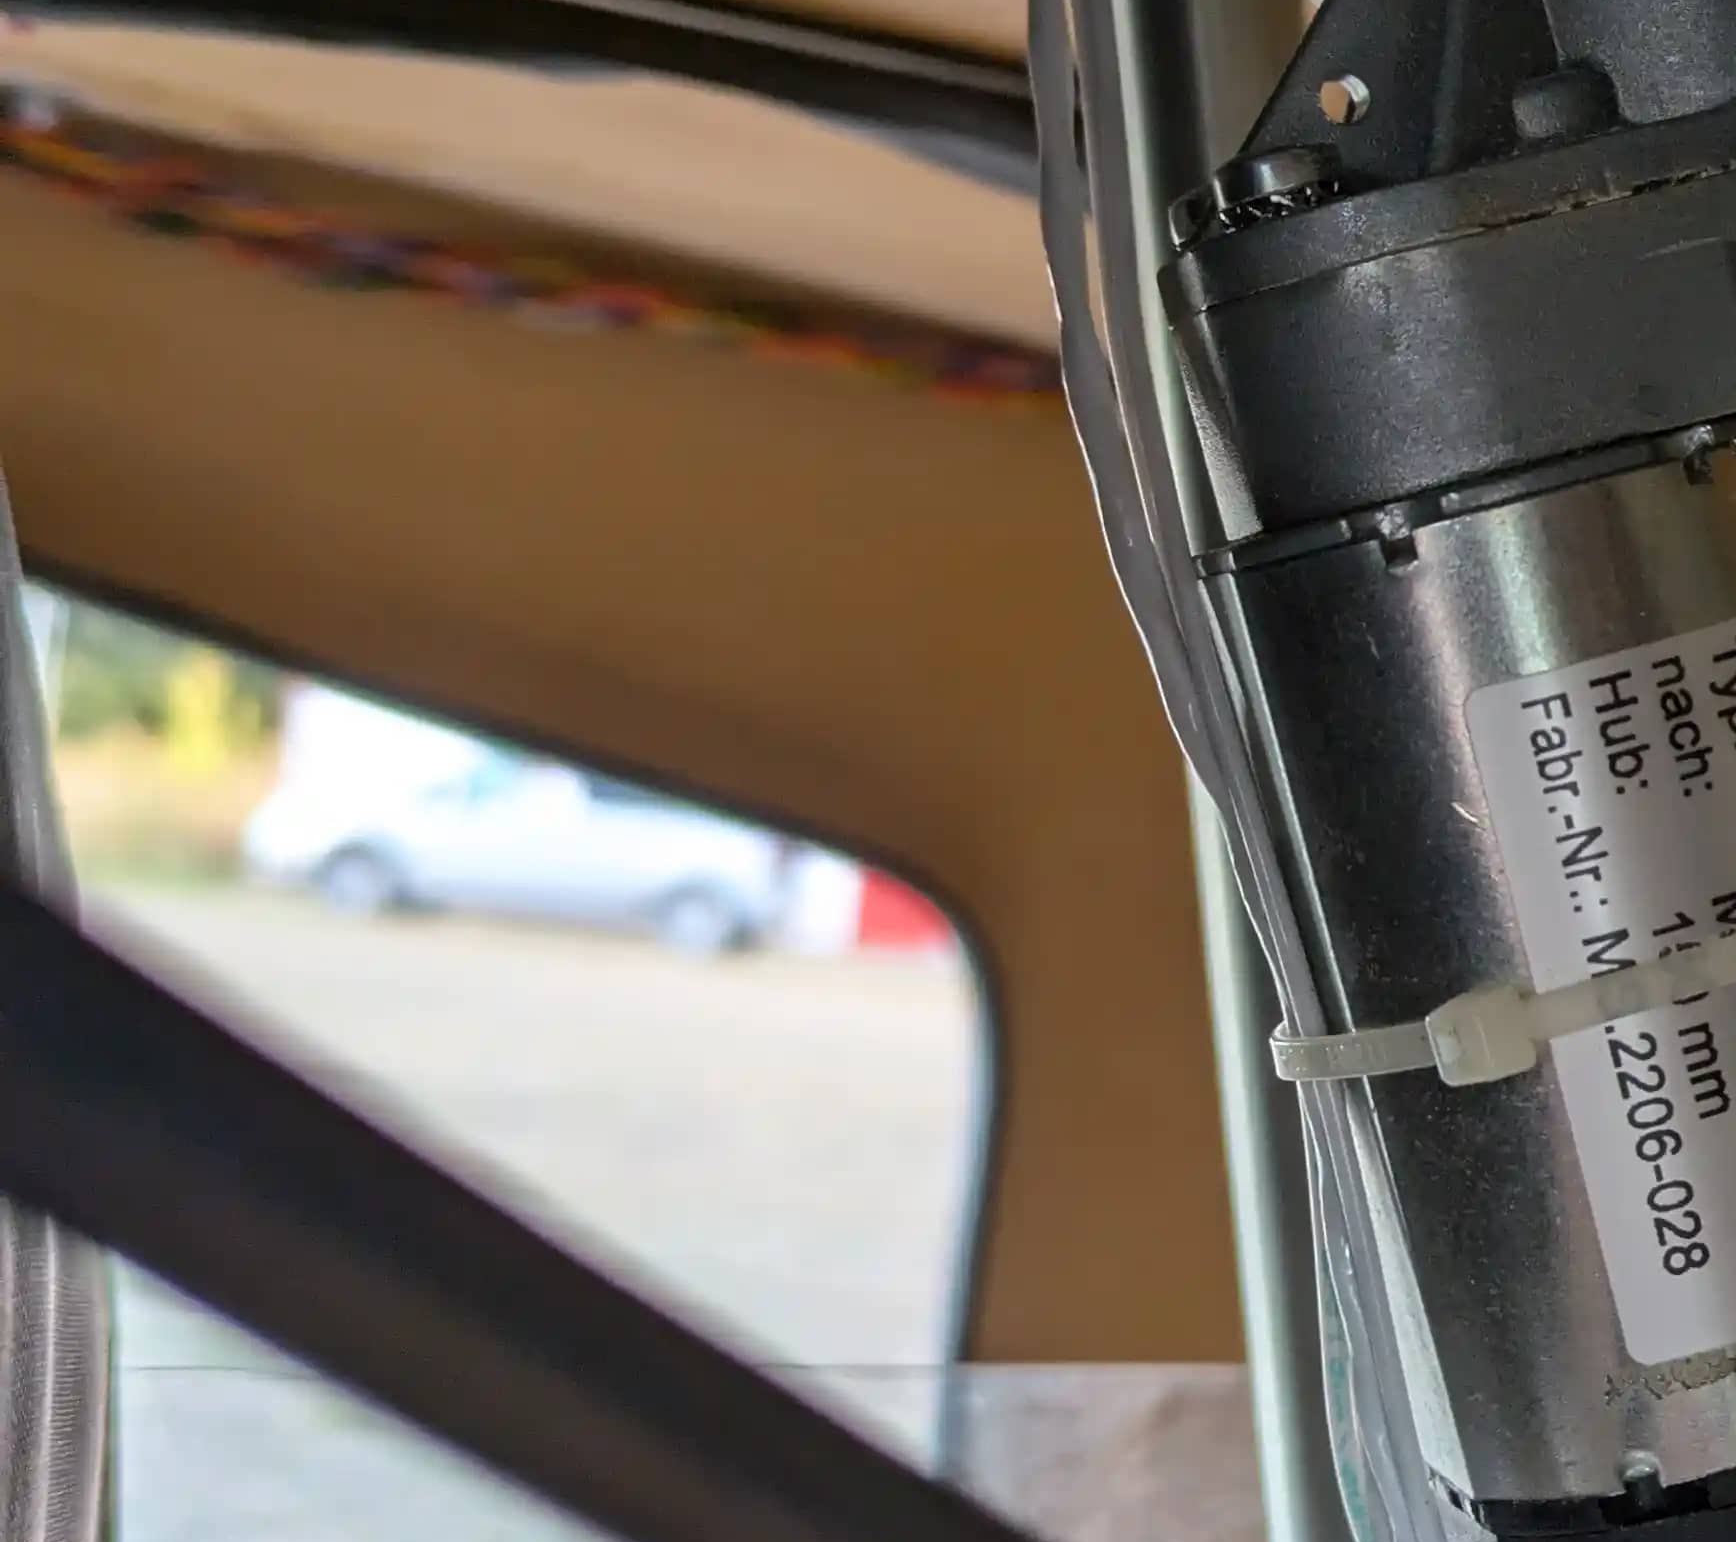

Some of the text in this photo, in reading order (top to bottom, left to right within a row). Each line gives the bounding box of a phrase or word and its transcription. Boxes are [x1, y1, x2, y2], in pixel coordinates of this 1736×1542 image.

[1589, 669, 1650, 797] Hub:
[1677, 1022, 1733, 1120] mm
[1652, 656, 1714, 798] nach:
[1521, 692, 1609, 913] Fabr.-Nr.:
[1581, 928, 1712, 1277] M.2206-028
